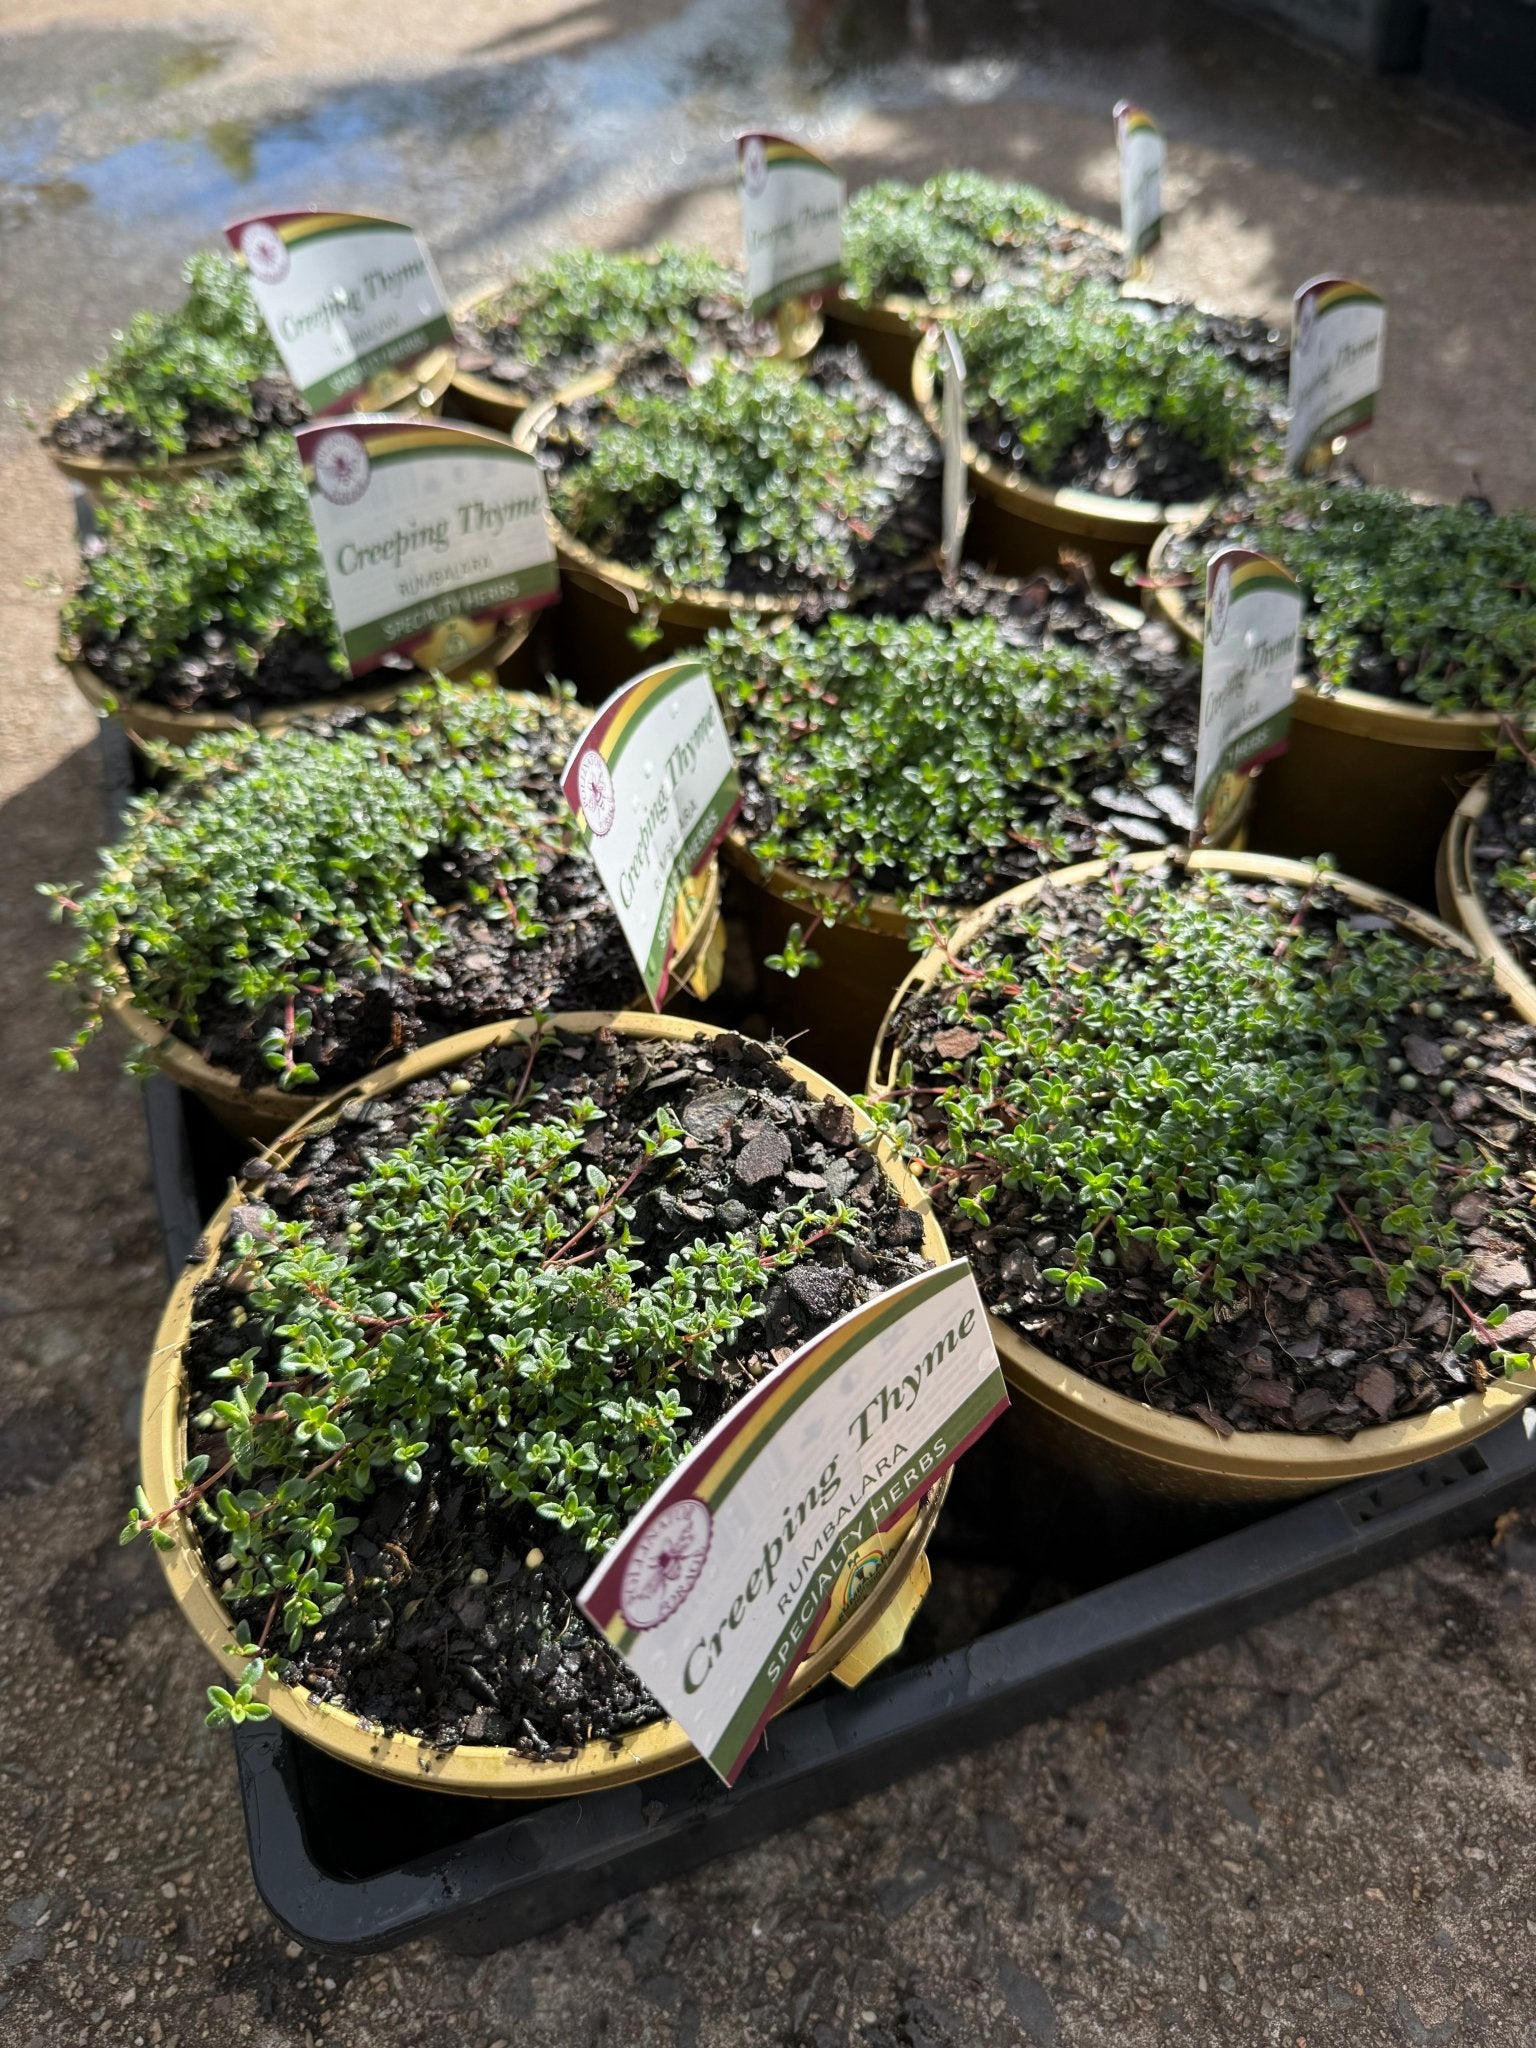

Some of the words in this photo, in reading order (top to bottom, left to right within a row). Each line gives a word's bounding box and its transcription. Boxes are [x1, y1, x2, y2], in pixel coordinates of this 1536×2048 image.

[336, 519, 449, 577] Creeping
[458, 495, 540, 537] Thyme
[618, 783, 672, 911] Creeping
[664, 704, 717, 786] Thyme
[682, 1454, 840, 1695] Creeping
[848, 1307, 975, 1454] Thyme
[767, 1520, 864, 1684] SPECIALTY
[870, 1437, 948, 1522] HERBS
[777, 1442, 909, 1616] RUMBALARA
